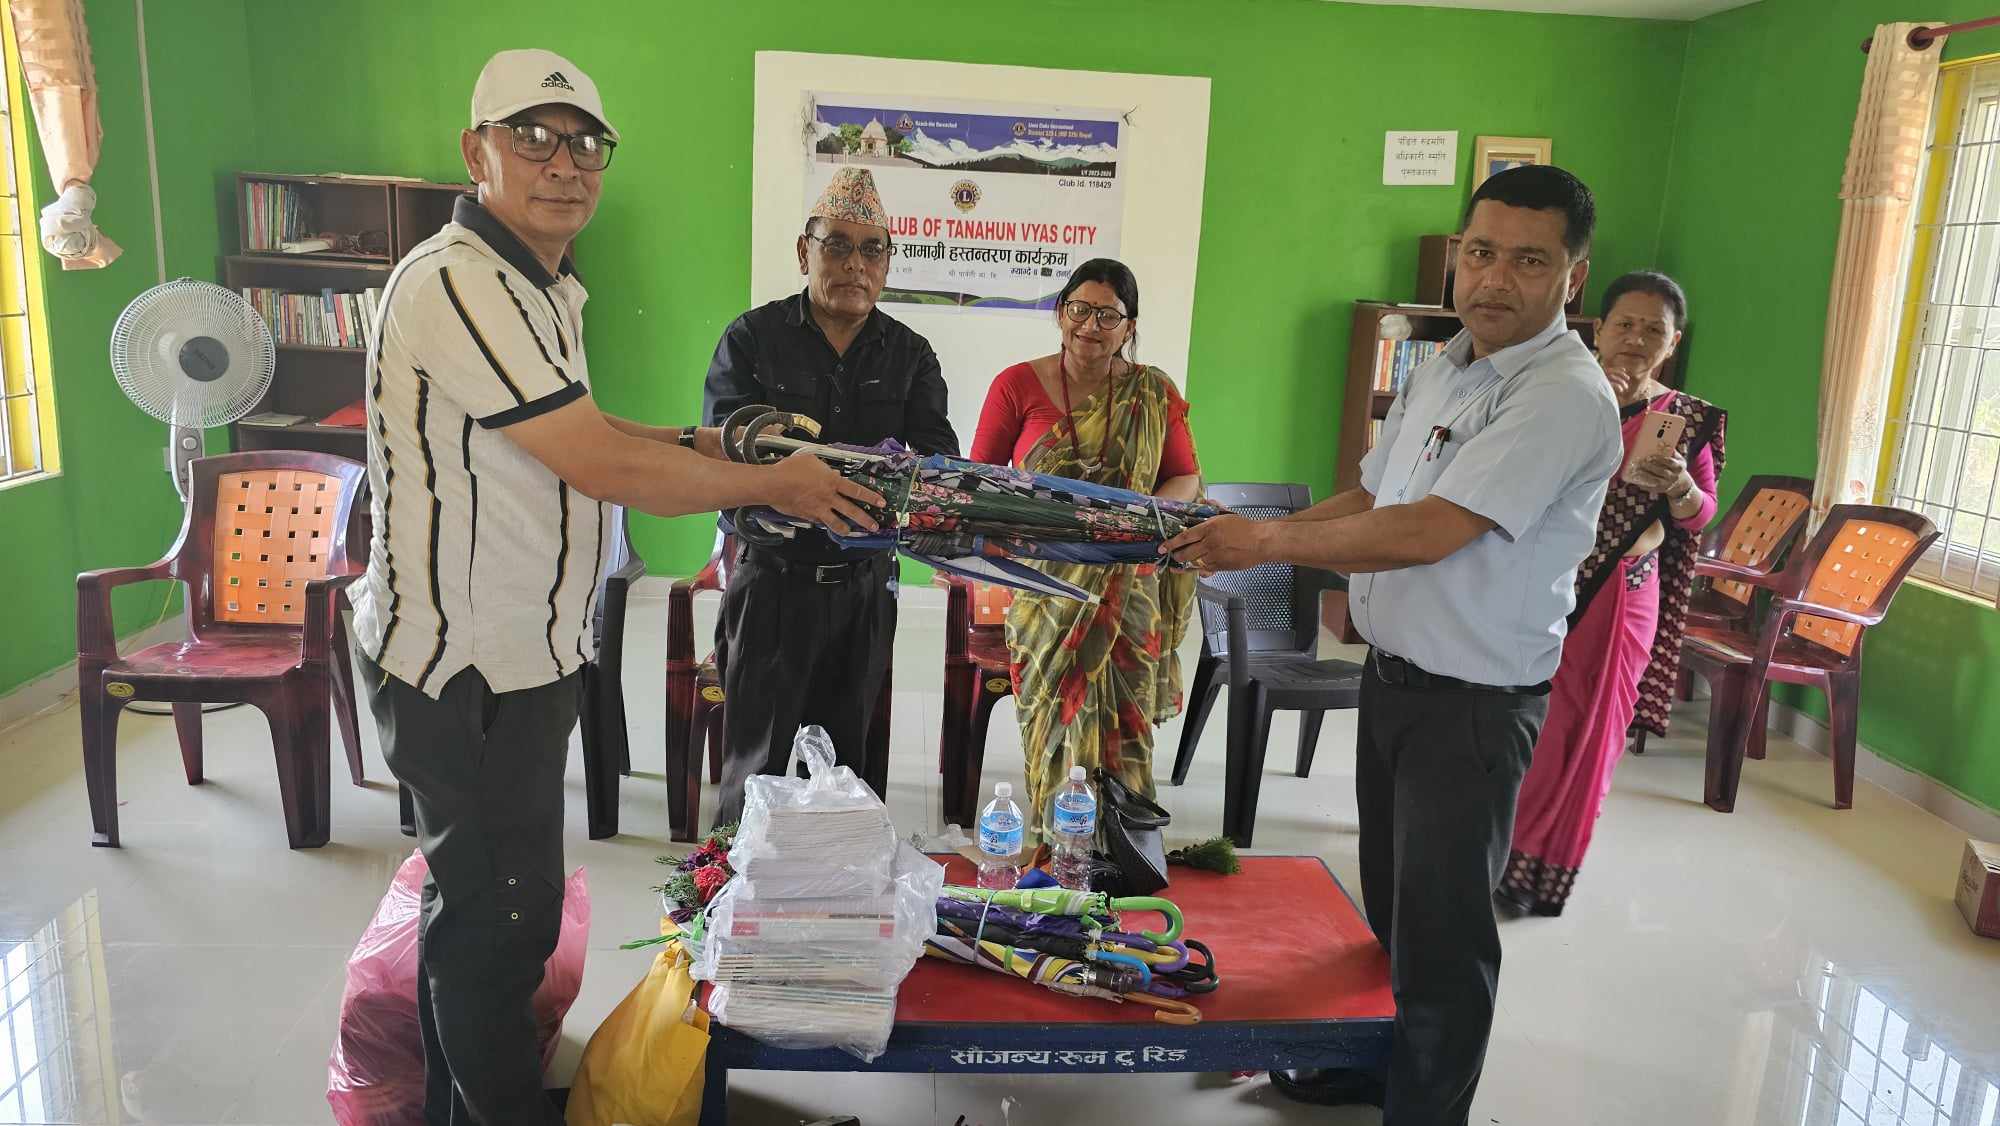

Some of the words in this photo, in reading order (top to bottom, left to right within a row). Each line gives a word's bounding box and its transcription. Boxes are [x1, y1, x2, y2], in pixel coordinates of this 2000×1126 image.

[541, 80, 575, 91] adidas
[889, 216, 918, 236] LUB
[923, 217, 942, 238] OF
[946, 219, 1016, 241] TANAHUN
[1021, 223, 1058, 244] VYAS
[1063, 225, 1097, 245] CITY
[1015, 247, 1069, 267] कार्यक्रम
